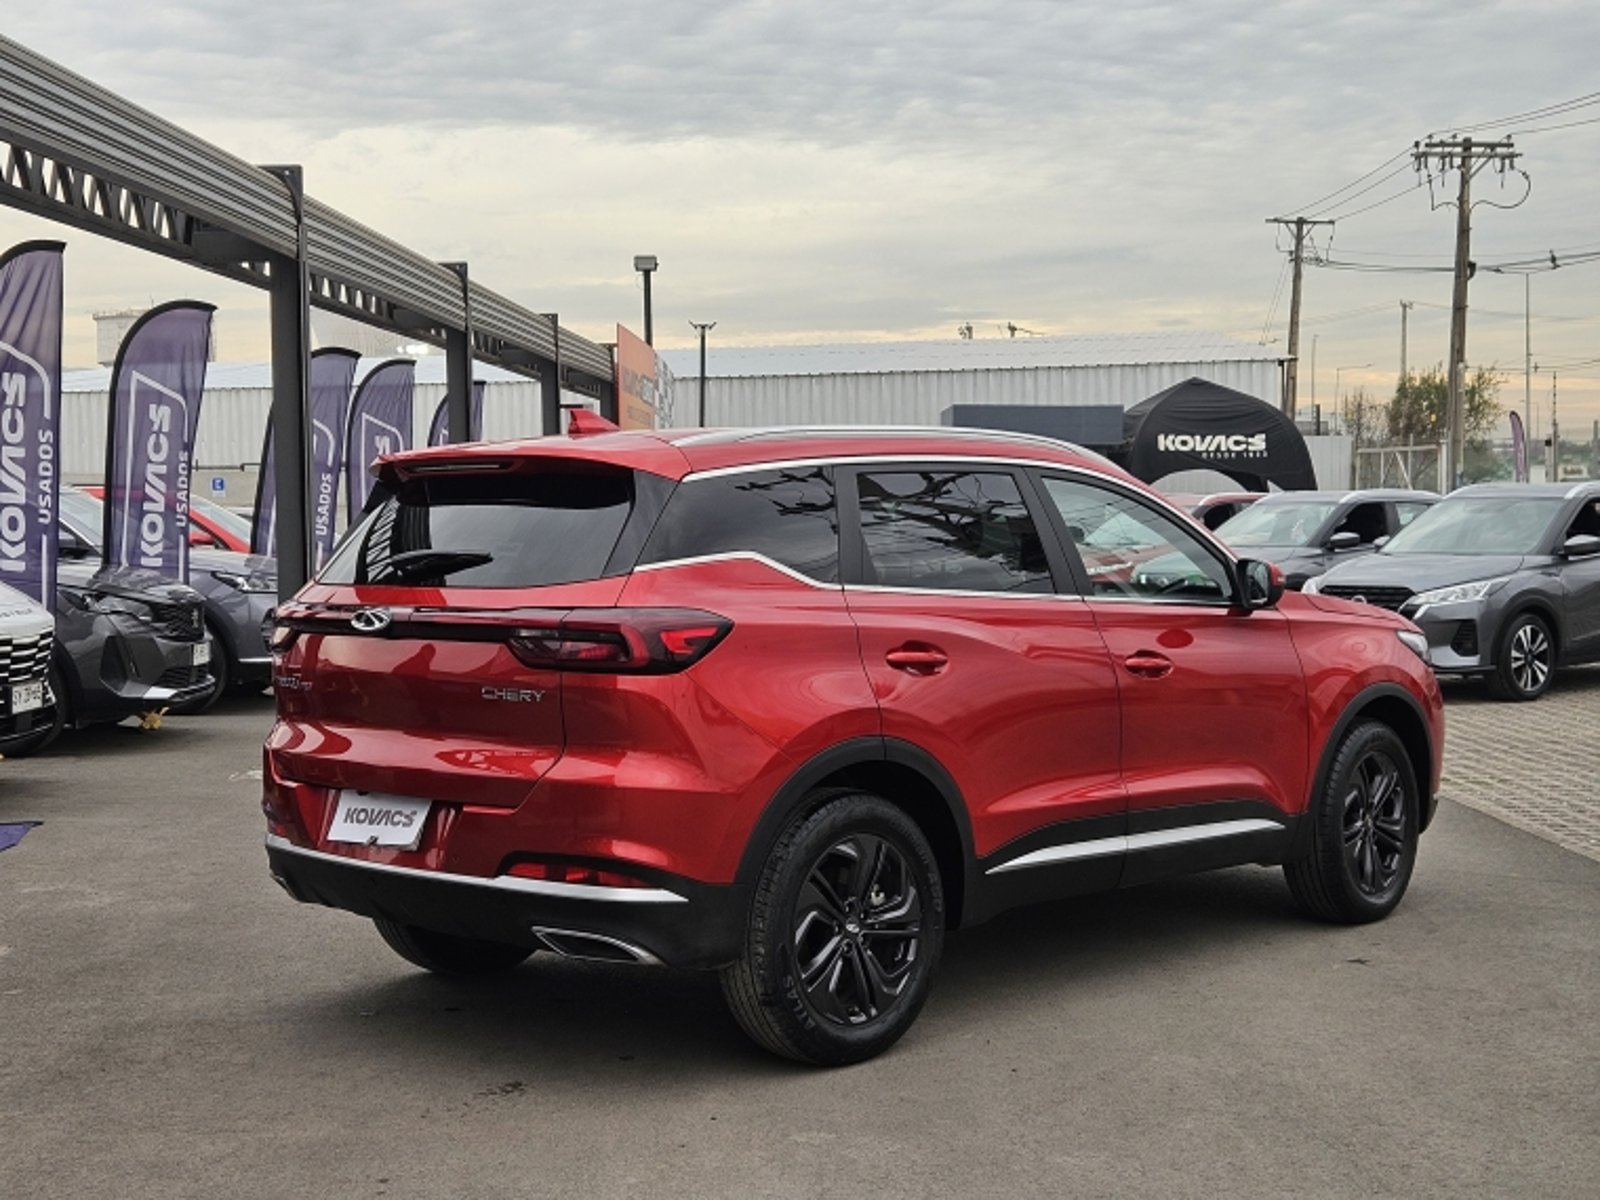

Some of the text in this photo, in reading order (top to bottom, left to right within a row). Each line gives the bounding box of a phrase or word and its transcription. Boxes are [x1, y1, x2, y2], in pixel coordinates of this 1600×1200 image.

[0, 372, 26, 573] KOVACS
[38, 428, 54, 526] USADOS
[1156, 433, 1267, 452] KOVACS
[140, 403, 172, 568] KOVACS
[175, 450, 189, 528] USADOS
[315, 472, 332, 536] USADOS
[481, 686, 546, 702] CHERY
[343, 806, 418, 828] KOVACS
